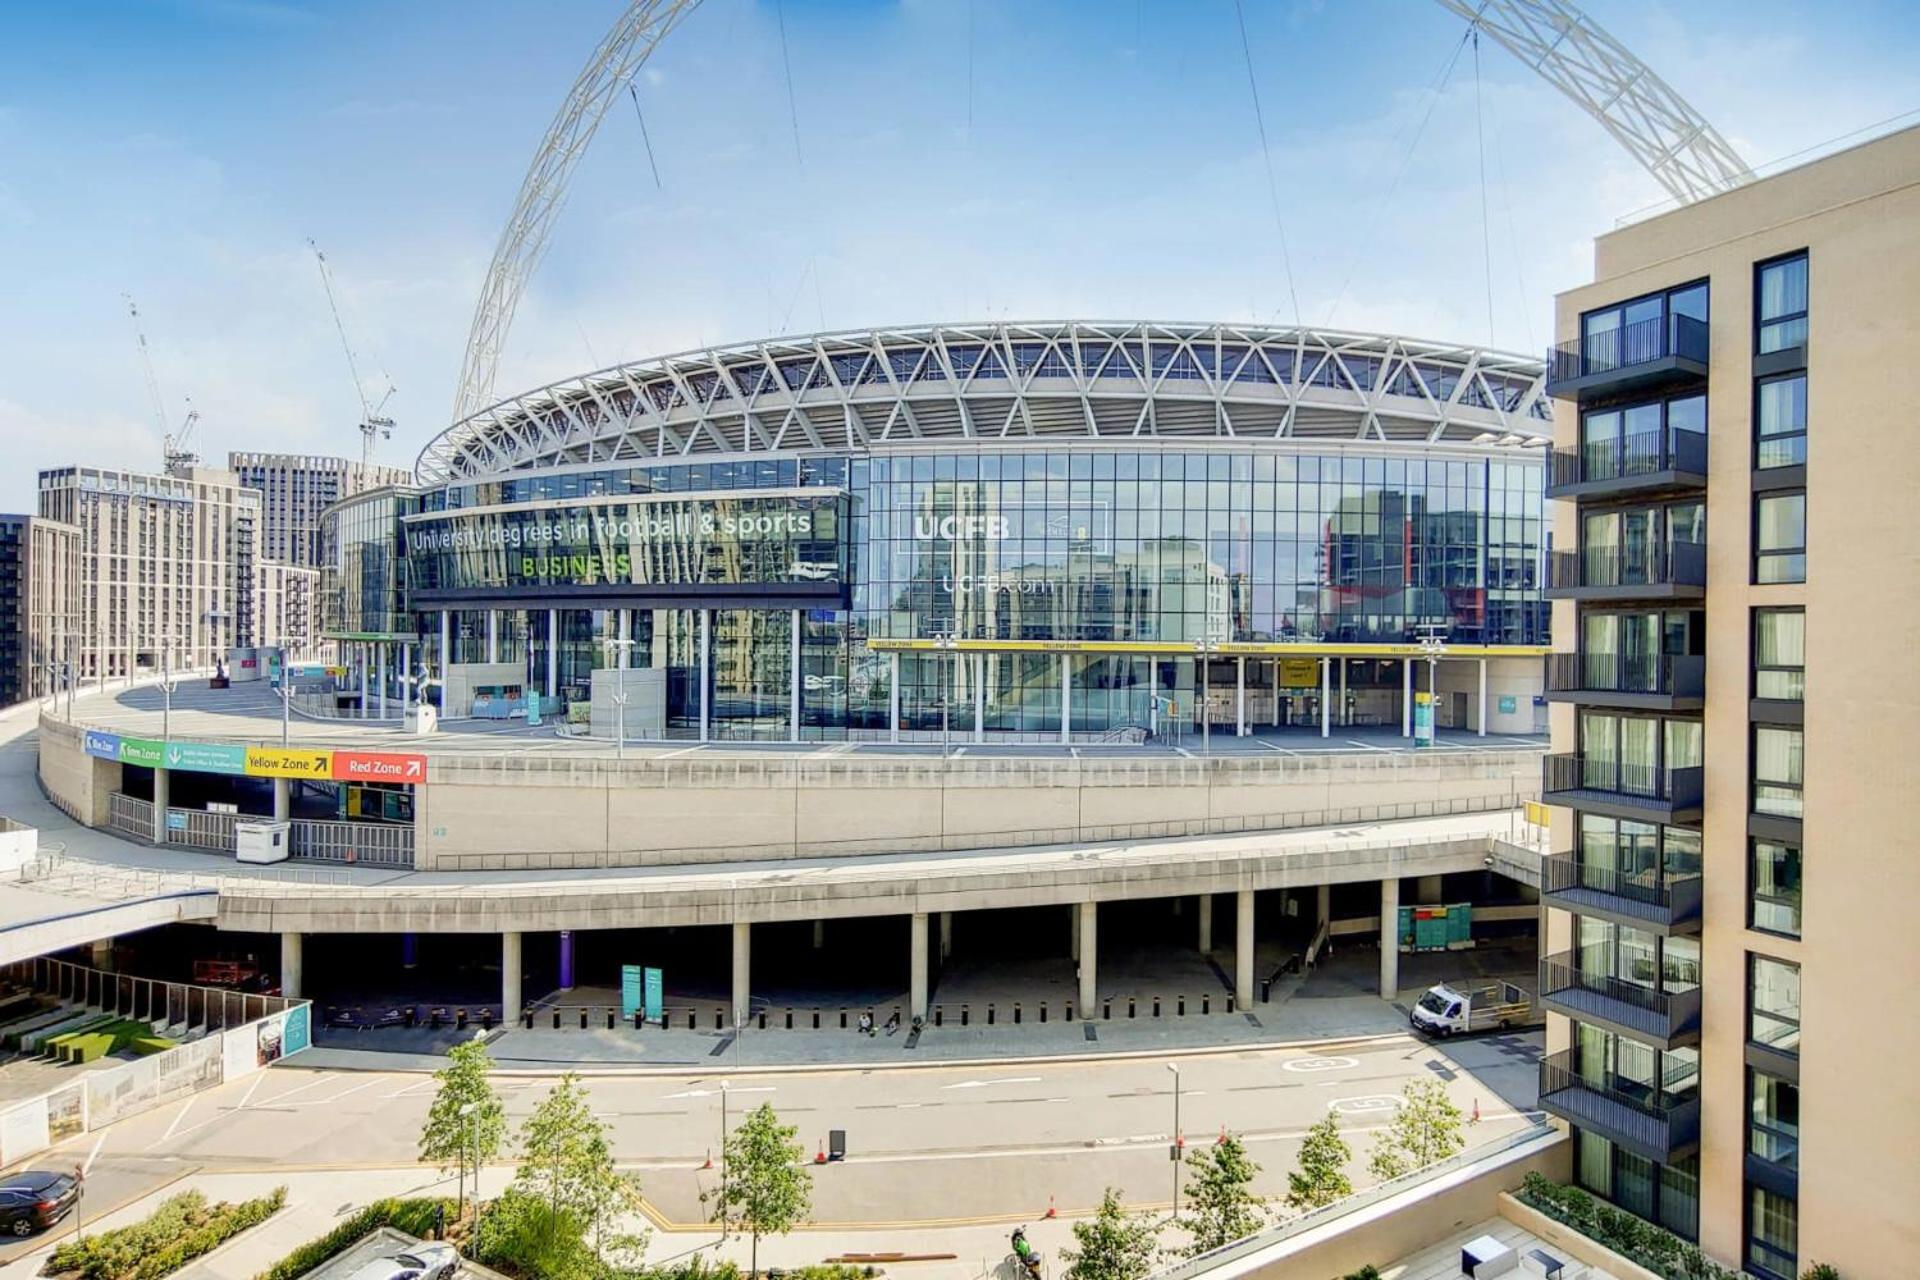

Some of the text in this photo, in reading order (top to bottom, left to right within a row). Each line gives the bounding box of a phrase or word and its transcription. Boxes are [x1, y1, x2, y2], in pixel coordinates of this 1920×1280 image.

[414, 512, 811, 550] University degrees in football & sports
[914, 515, 1009, 540] UCFB
[522, 554, 630, 577] BUSINES
[943, 575, 1054, 593] UCFB.com
[142, 747, 161, 761] Zone
[249, 756, 279, 769] Yellow
[282, 757, 309, 770] Zone
[350, 760, 402, 774] Red Zone
